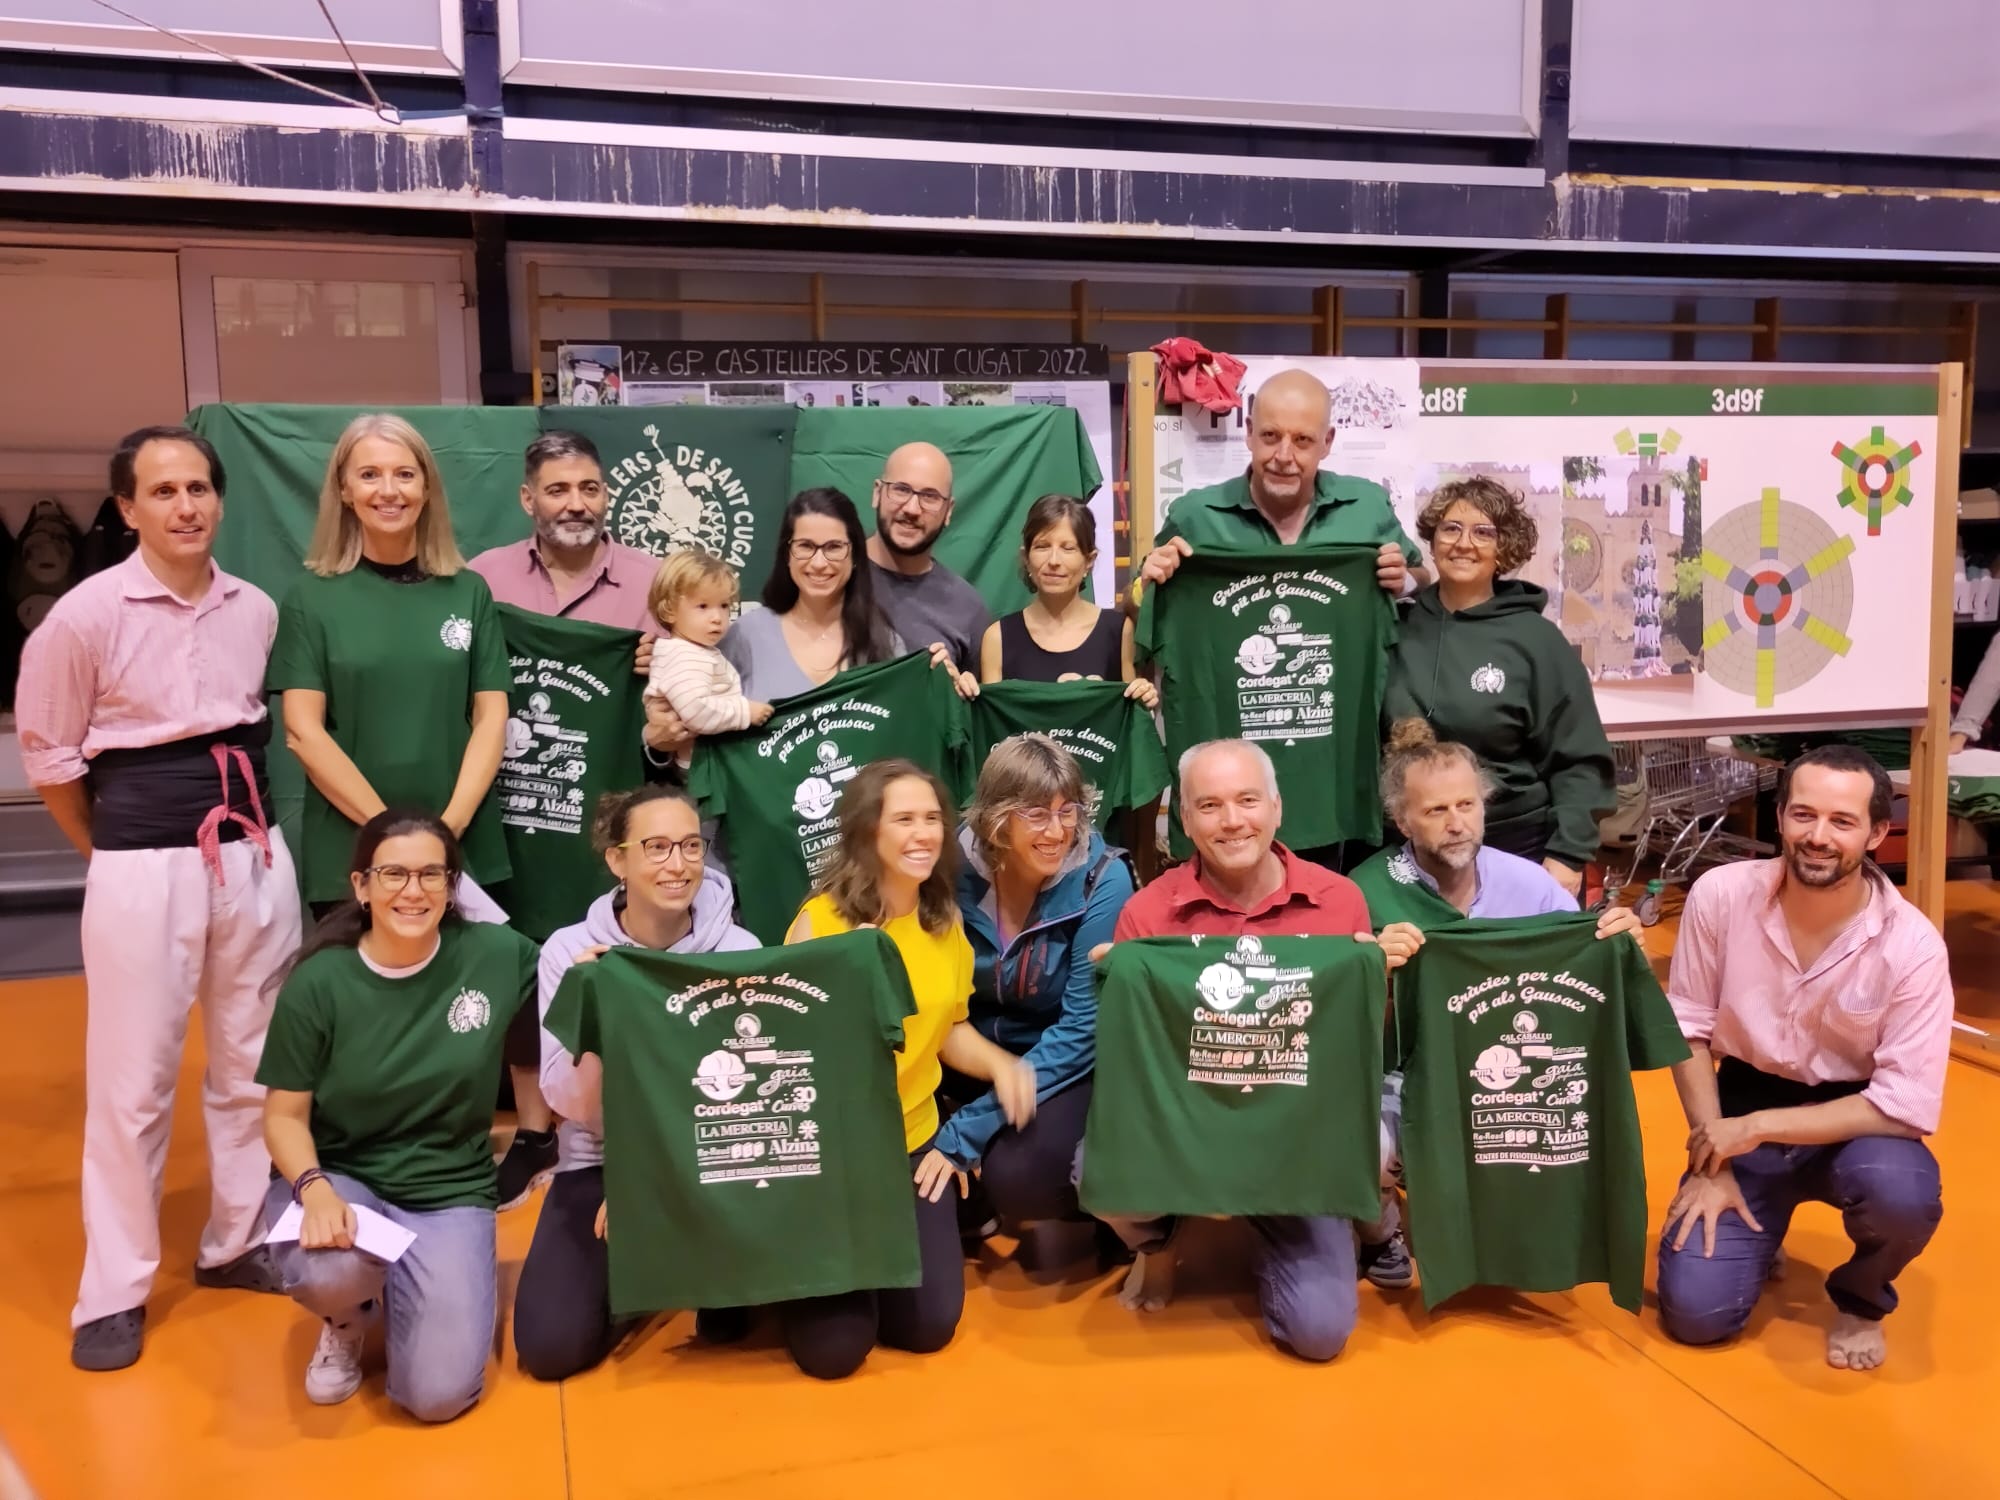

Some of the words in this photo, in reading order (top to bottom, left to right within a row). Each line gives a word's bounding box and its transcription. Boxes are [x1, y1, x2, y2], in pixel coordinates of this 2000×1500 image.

[715, 349, 849, 376] CASTELLERS
[856, 349, 884, 375] DE
[889, 348, 945, 376] SANT
[954, 348, 1029, 376] CUGAT
[1037, 349, 1091, 375] 2022
[1711, 387, 1765, 413] 3d9f
[676, 445, 705, 470] DE
[704, 457, 751, 507] SANT
[725, 510, 755, 579] CUGA
[1272, 570, 1300, 584] per
[1302, 569, 1350, 596] donar
[1231, 596, 1250, 617] pit
[1251, 586, 1272, 603] als
[1275, 583, 1332, 604] Gausacs
[514, 671, 535, 685] als
[538, 672, 593, 702] Gausacs
[537, 658, 564, 671] per
[566, 664, 612, 697] donar
[1236, 674, 1292, 689] Cordegat
[1242, 695, 1257, 706] LA
[1258, 691, 1312, 704] MERCERIA
[811, 701, 839, 722] per
[841, 698, 891, 719] donar
[778, 740, 795, 764] pit
[795, 726, 815, 745] als
[817, 717, 876, 736] Gausacs
[1048, 728, 1074, 739] per
[1055, 741, 1105, 763] ausacs
[500, 759, 542, 775] rdegat
[797, 815, 842, 837] Cordeg
[805, 840, 821, 854] LA
[1224, 951, 1241, 961] CAL
[665, 977, 730, 1015] Gràcies
[735, 974, 769, 989] per
[771, 972, 832, 1003] donar
[1255, 980, 1310, 1010] gaia
[1447, 974, 1511, 1013] Gràcies
[1516, 971, 1550, 986] per
[1552, 970, 1608, 1004] donar
[688, 1004, 712, 1027] pit
[712, 992, 737, 1009] als
[740, 988, 809, 1014] Gausacs
[1290, 1000, 1313, 1018] 30
[1468, 1001, 1490, 1024] pit
[1491, 990, 1516, 1008] als
[1519, 986, 1587, 1013] Gausacs
[1193, 1006, 1262, 1028] Cordegat
[1196, 1029, 1214, 1043] LA
[1216, 1031, 1281, 1047] MERCERIA
[1258, 1048, 1309, 1064] Alzina
[756, 1065, 812, 1096] gaia
[1531, 1060, 1584, 1089] gaia
[792, 1086, 817, 1103] 30
[1471, 1090, 1538, 1106] Cordegat
[1567, 1079, 1589, 1097] 30
[693, 1101, 765, 1117] Cordegat
[1476, 1114, 1494, 1125] LA
[1495, 1111, 1562, 1125] MERCERIA
[700, 1126, 720, 1138] LA
[720, 1120, 788, 1136] MERCERIA
[1541, 1129, 1589, 1144] Alzina
[768, 1138, 820, 1155] Alzina
